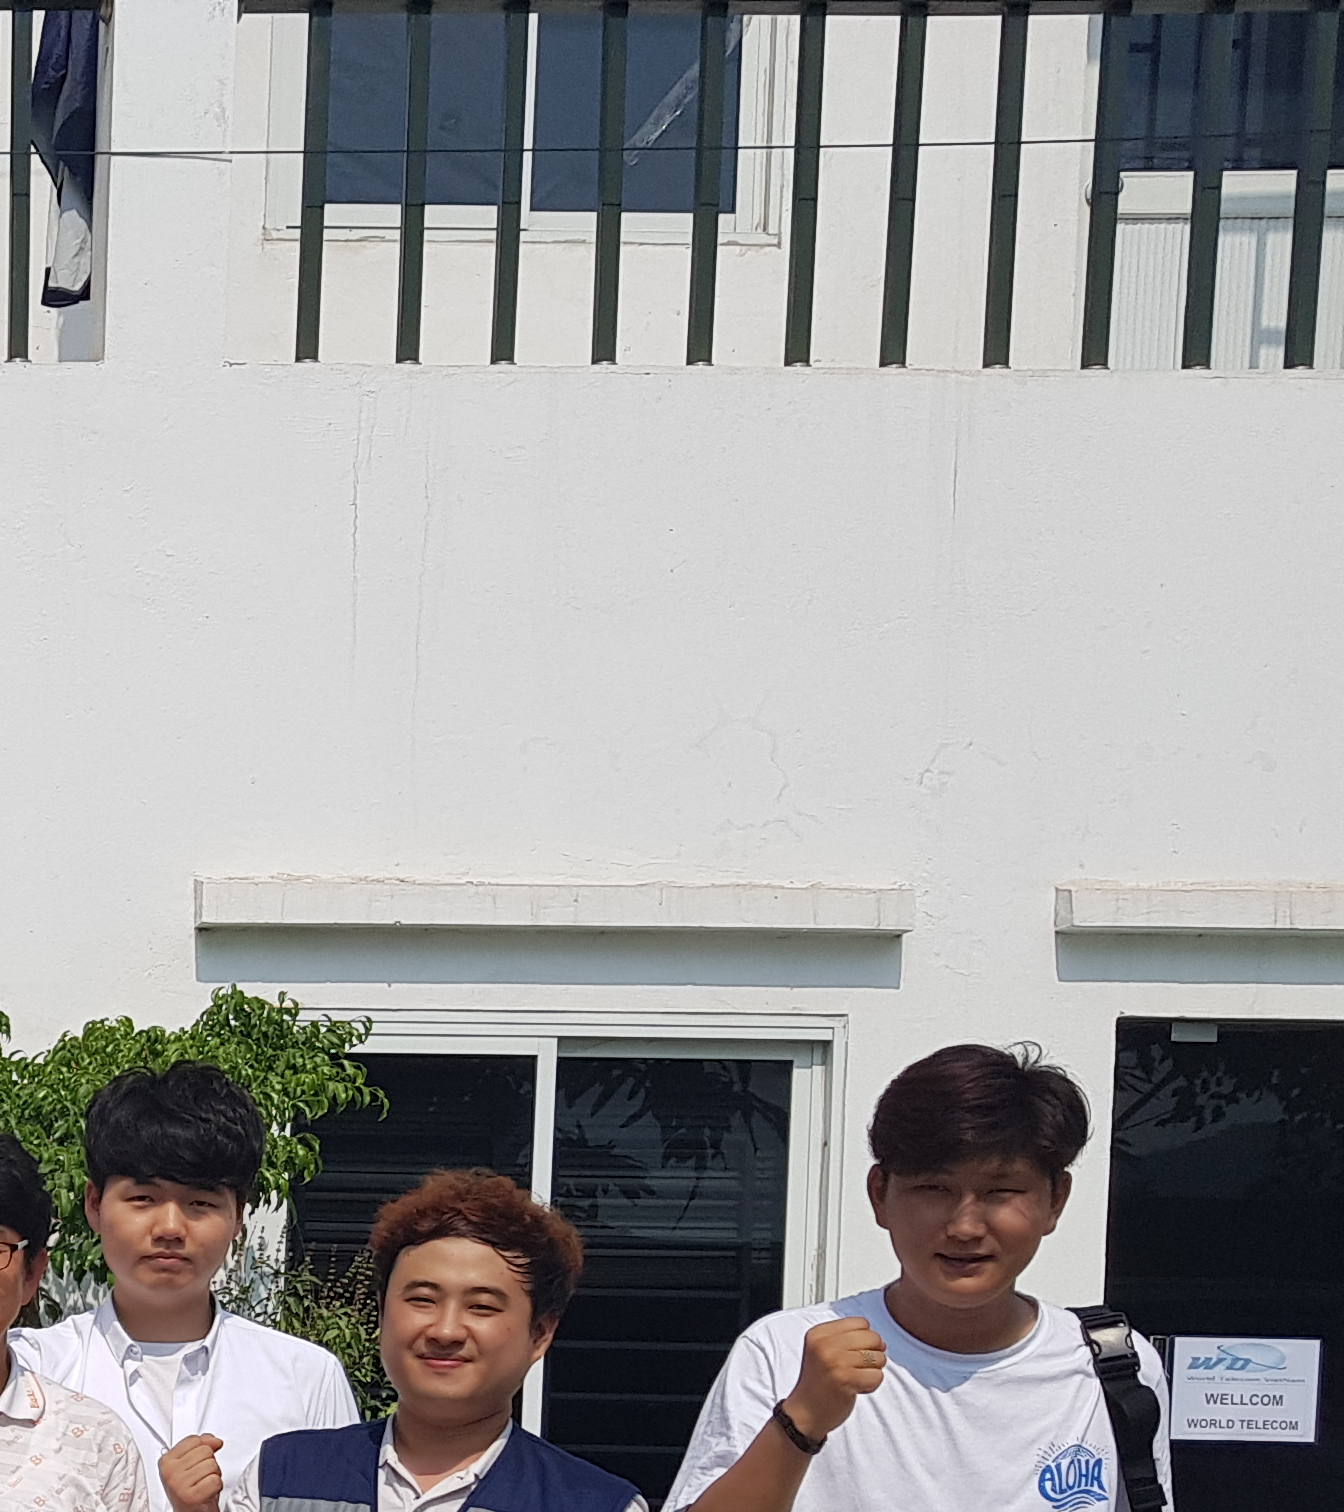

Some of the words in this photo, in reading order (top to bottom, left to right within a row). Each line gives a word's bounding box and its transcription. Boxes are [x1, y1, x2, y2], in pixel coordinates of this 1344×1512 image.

[1204, 1393, 1284, 1407] WELLCOM
[1186, 1418, 1235, 1429] WORLD
[1238, 1419, 1299, 1431] TELECOM
[1038, 1457, 1108, 1502] ALOHA
